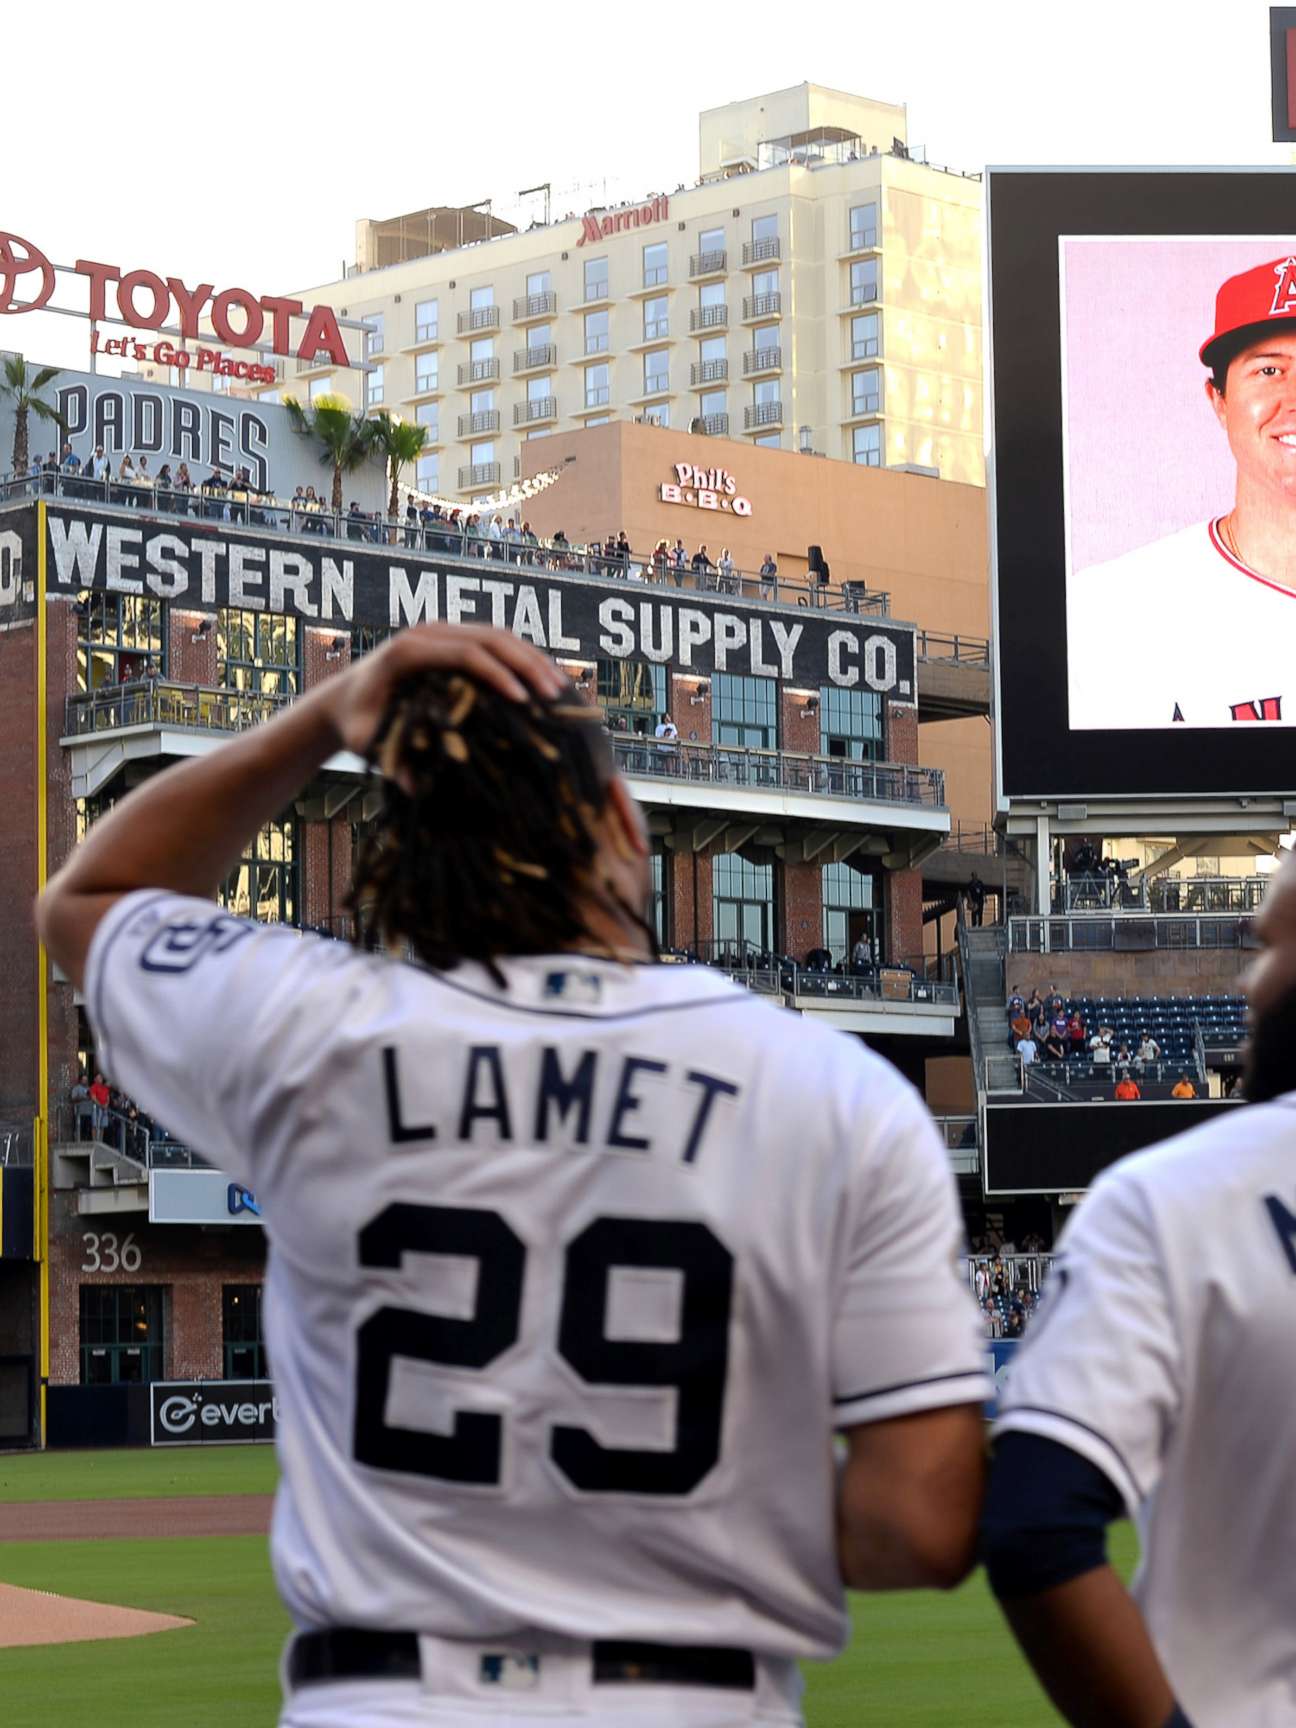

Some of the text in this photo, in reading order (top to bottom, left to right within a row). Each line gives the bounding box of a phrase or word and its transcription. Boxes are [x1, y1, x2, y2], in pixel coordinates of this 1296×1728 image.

[576, 195, 669, 247] Marriott
[76, 259, 351, 367] TOYOTA
[91, 330, 276, 384] Let's Go Places
[55, 384, 271, 492] PADRES
[673, 462, 736, 495] Phil's
[47, 516, 911, 695] WESTERN METAL SUPPLY CO.
[381, 1044, 740, 1165] LAMET
[80, 1232, 142, 1274] 336
[352, 1201, 737, 1497] 29
